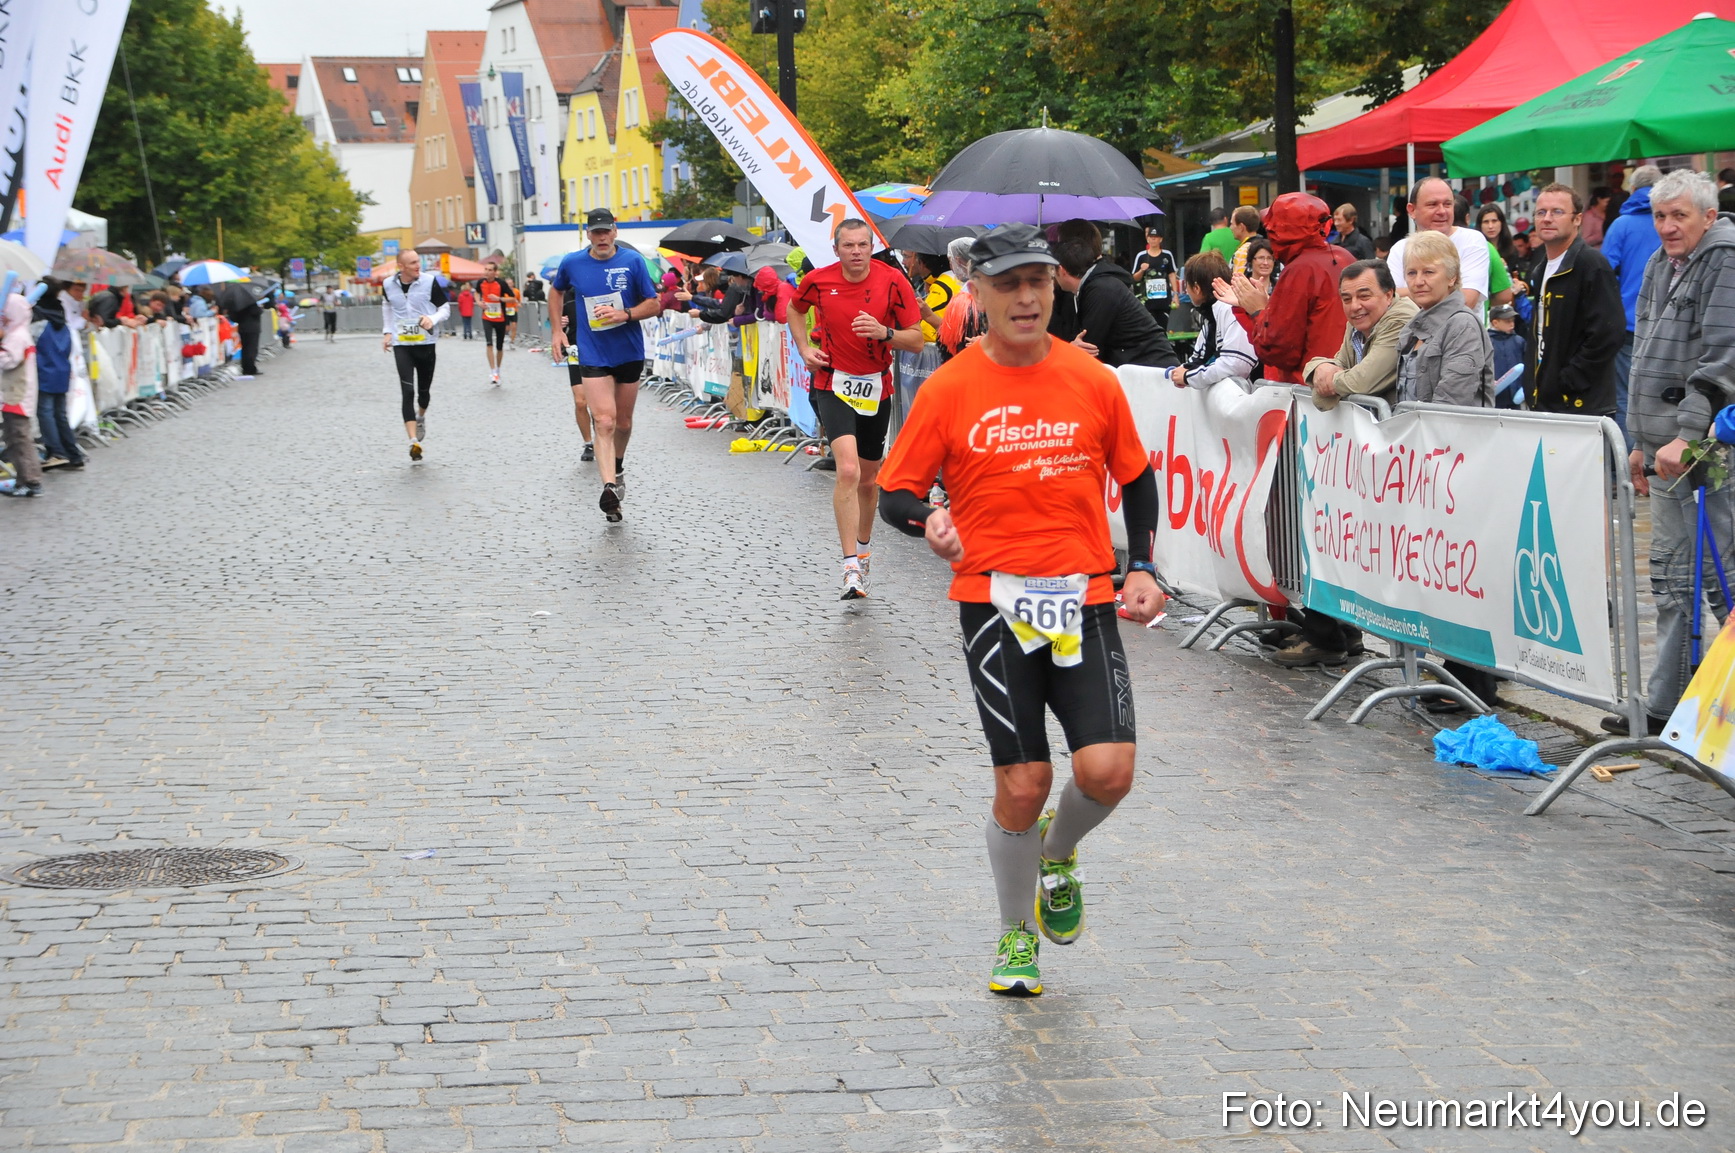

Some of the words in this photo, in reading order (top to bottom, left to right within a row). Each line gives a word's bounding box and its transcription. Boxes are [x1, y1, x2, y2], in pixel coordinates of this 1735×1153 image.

[59, 37, 88, 106] BKK
[45, 112, 75, 191] Audi
[1028, 240, 1048, 249] 2XU
[402, 325, 419, 335] 540
[842, 380, 873, 398] 340
[986, 418, 1080, 446] Fischer
[995, 438, 1074, 455] AUTOMOBILE
[1012, 458, 1032, 473] und
[1033, 455, 1053, 466] das
[1024, 578, 1068, 589] BOCK
[1013, 596, 1078, 629] 666
[1339, 597, 1431, 640] www.jura-gebaeudeservice.de
[1528, 648, 1548, 670] Gebäude
[1546, 655, 1566, 677] Service
[1566, 661, 1587, 683] GmbH
[1110, 650, 1135, 733] 2XU
